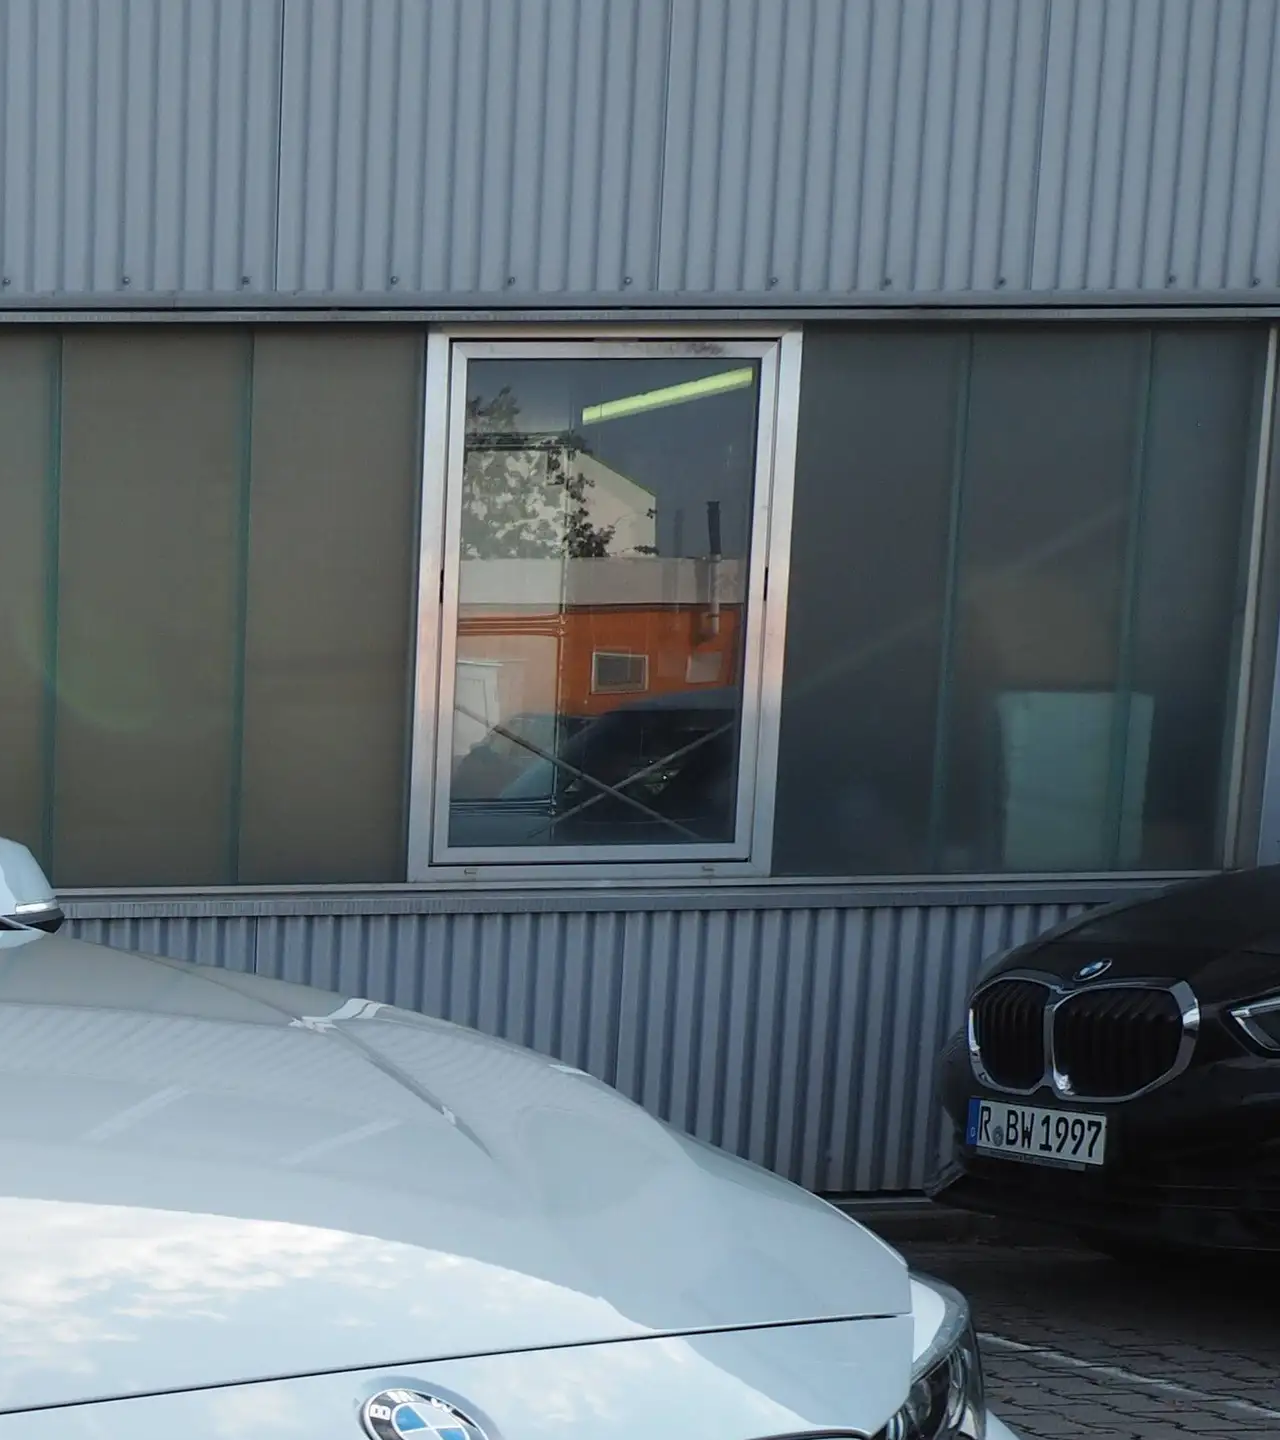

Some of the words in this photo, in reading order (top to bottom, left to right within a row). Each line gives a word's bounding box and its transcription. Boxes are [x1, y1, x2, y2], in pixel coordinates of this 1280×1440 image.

[979, 1106, 991, 1142] R
[1005, 1110, 1034, 1149] BW
[1039, 1115, 1103, 1158] 1997
